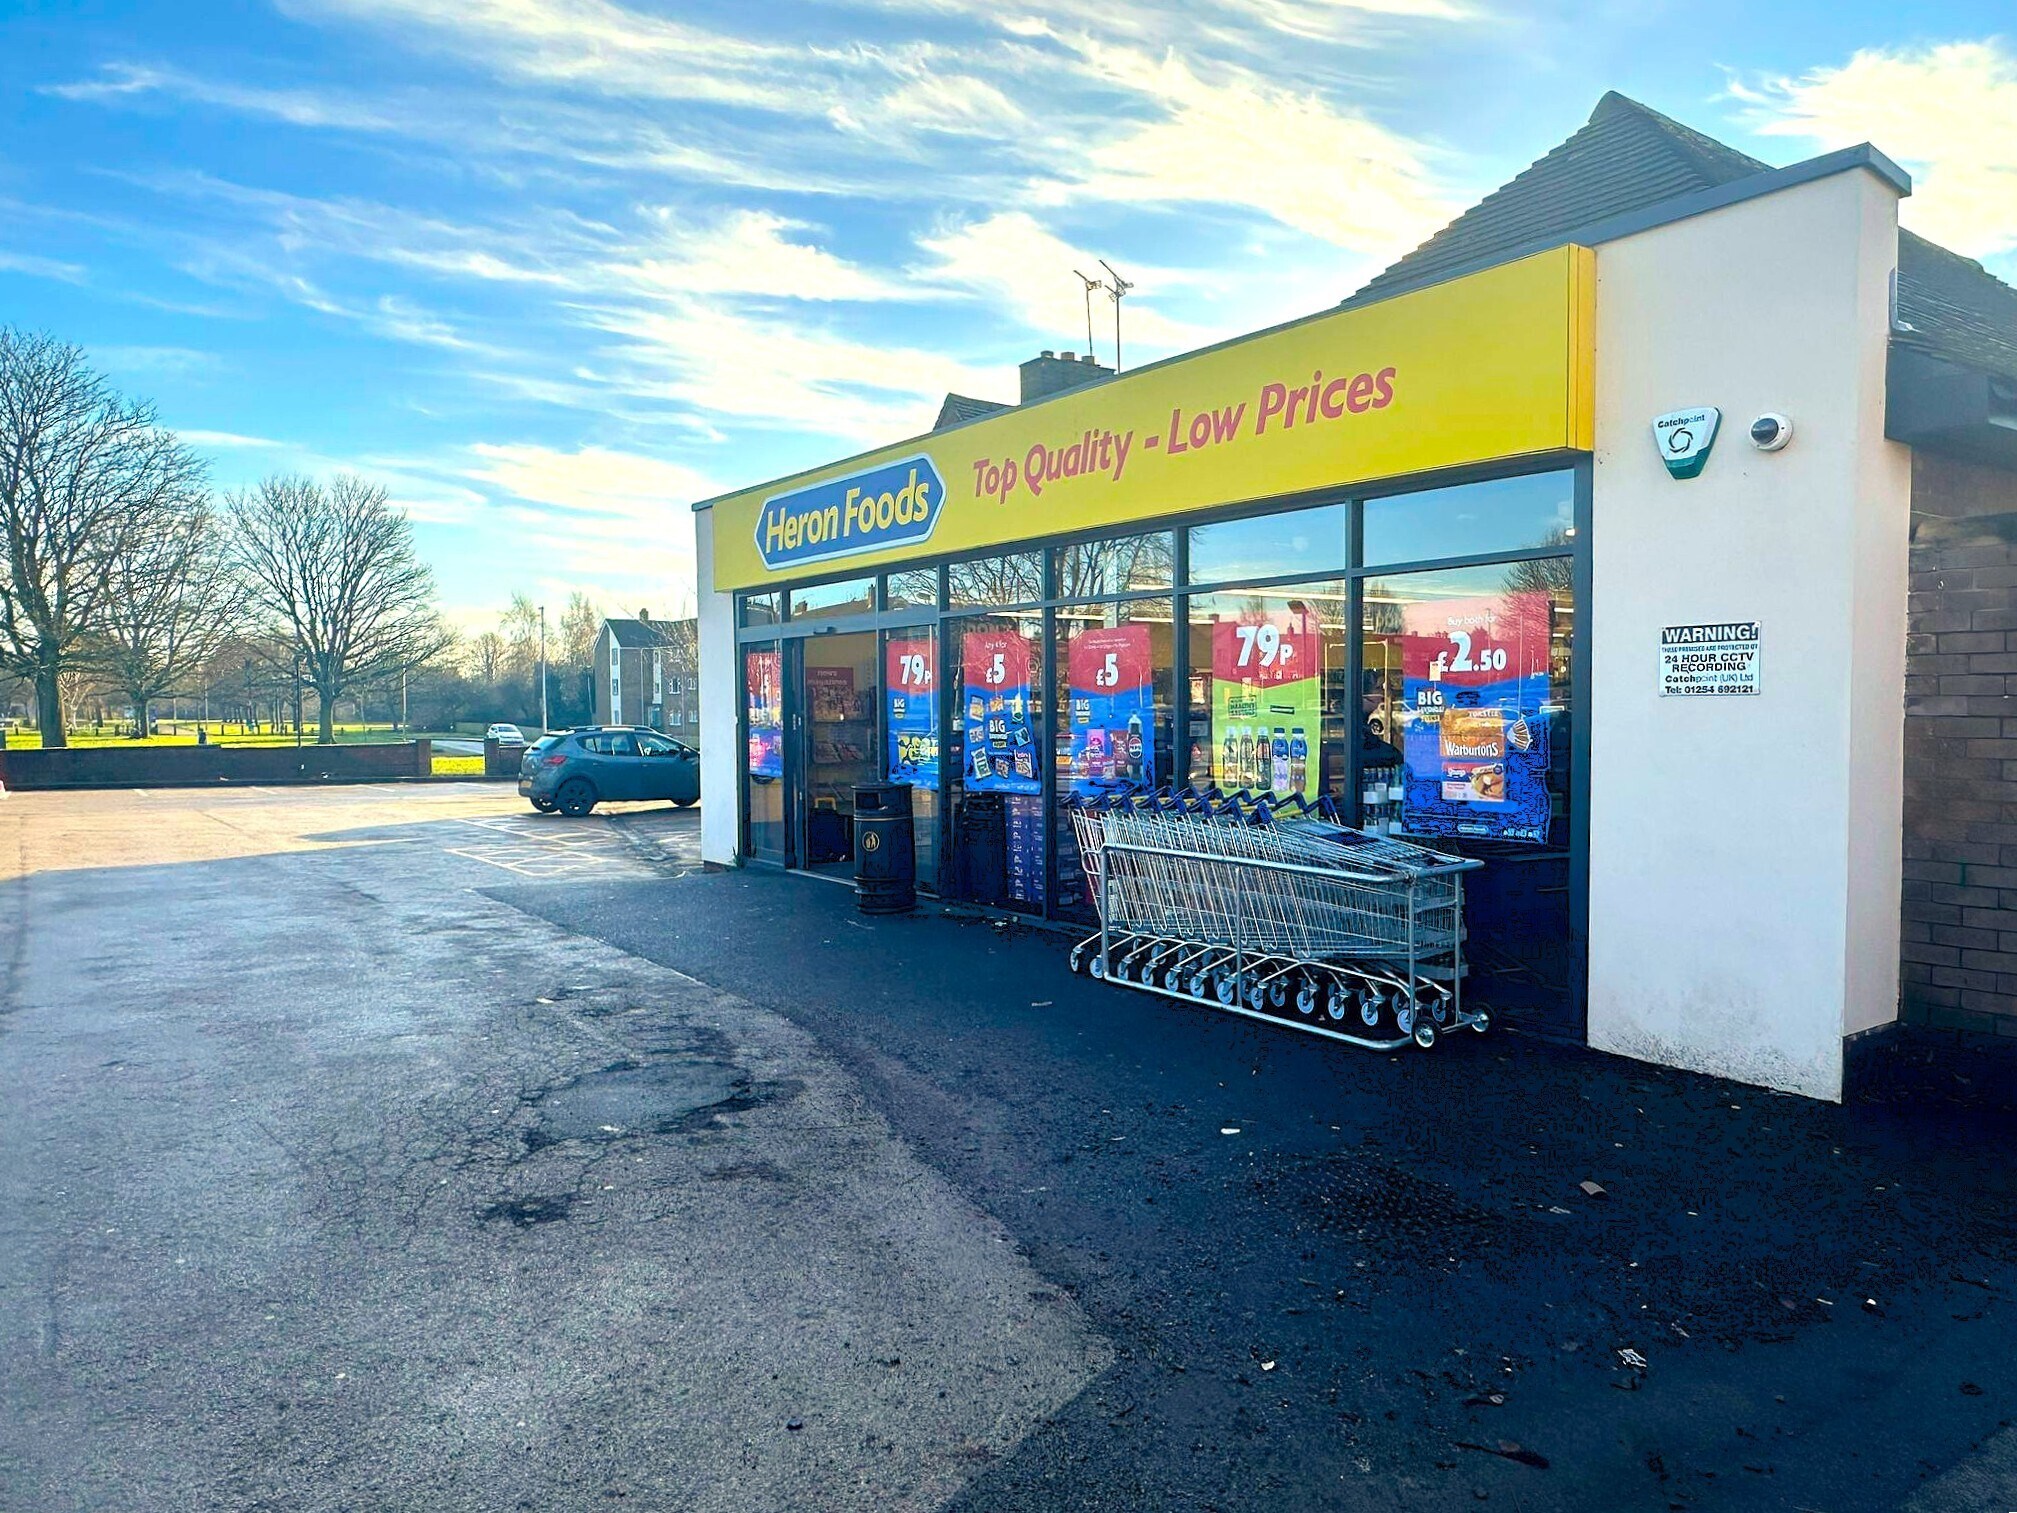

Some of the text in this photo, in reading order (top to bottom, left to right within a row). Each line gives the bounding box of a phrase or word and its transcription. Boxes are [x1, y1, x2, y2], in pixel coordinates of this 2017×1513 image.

[1657, 413, 1705, 429] Catchpoint
[973, 366, 1397, 504] Top Quality - Low Prices
[765, 468, 931, 554] Heron Foods
[1664, 624, 1756, 643] WARNING!
[1235, 623, 1294, 668] 79p
[1437, 630, 1508, 673] £2.50
[1665, 652, 1754, 664] 24 HOUR CCTV
[899, 654, 932, 686] 79p
[985, 653, 1006, 684] £5
[1096, 652, 1119, 687] £5
[1672, 662, 1746, 673] RECORDING
[1665, 674, 1717, 683] Catchpoint
[1417, 691, 1443, 705] BIG
[1665, 685, 1682, 694] Tel:
[1684, 685, 1715, 694] 01254
[989, 719, 1006, 733] BIG
[1445, 741, 1499, 757] Warburtons
